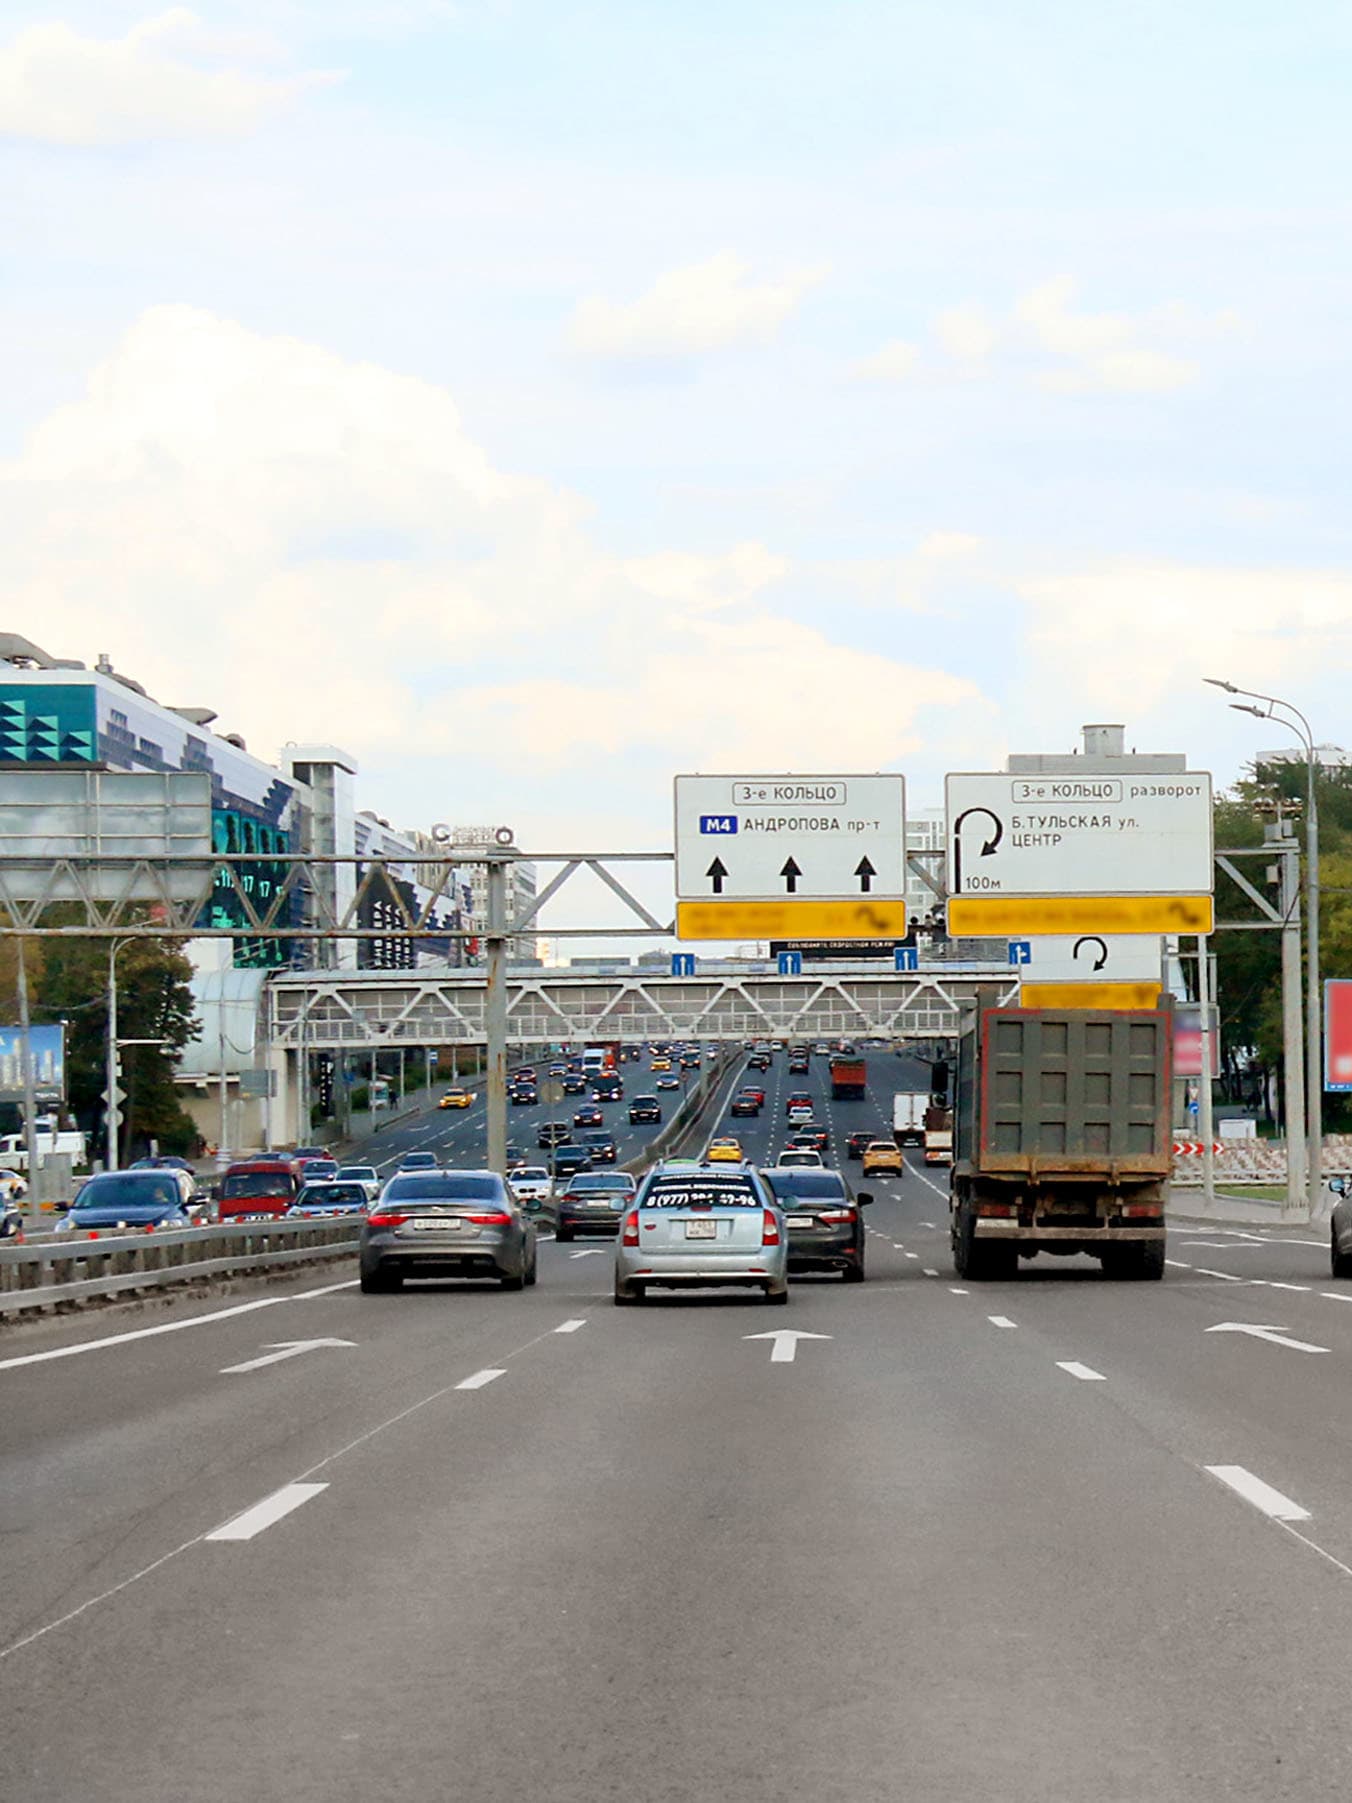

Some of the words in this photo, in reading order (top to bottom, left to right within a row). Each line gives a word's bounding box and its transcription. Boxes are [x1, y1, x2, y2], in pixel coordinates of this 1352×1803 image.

[742, 786, 767, 800] 3-е
[774, 786, 837, 801] КОЛЬЦО
[1021, 784, 1046, 798] 3-е
[1052, 784, 1113, 798] КОЛЬЦО
[1130, 786, 1201, 798] разворот
[706, 818, 731, 832] М4
[743, 818, 840, 832] АНДРОПОВА
[847, 819, 880, 833] пр-т
[1011, 815, 1111, 829] Б.ТУЛЬСКАЯ
[1118, 818, 1140, 830] ул.
[1011, 834, 1062, 848] ЦЕНТР
[965, 876, 1001, 890] 100м
[373, 900, 383, 967] РИВЕРА
